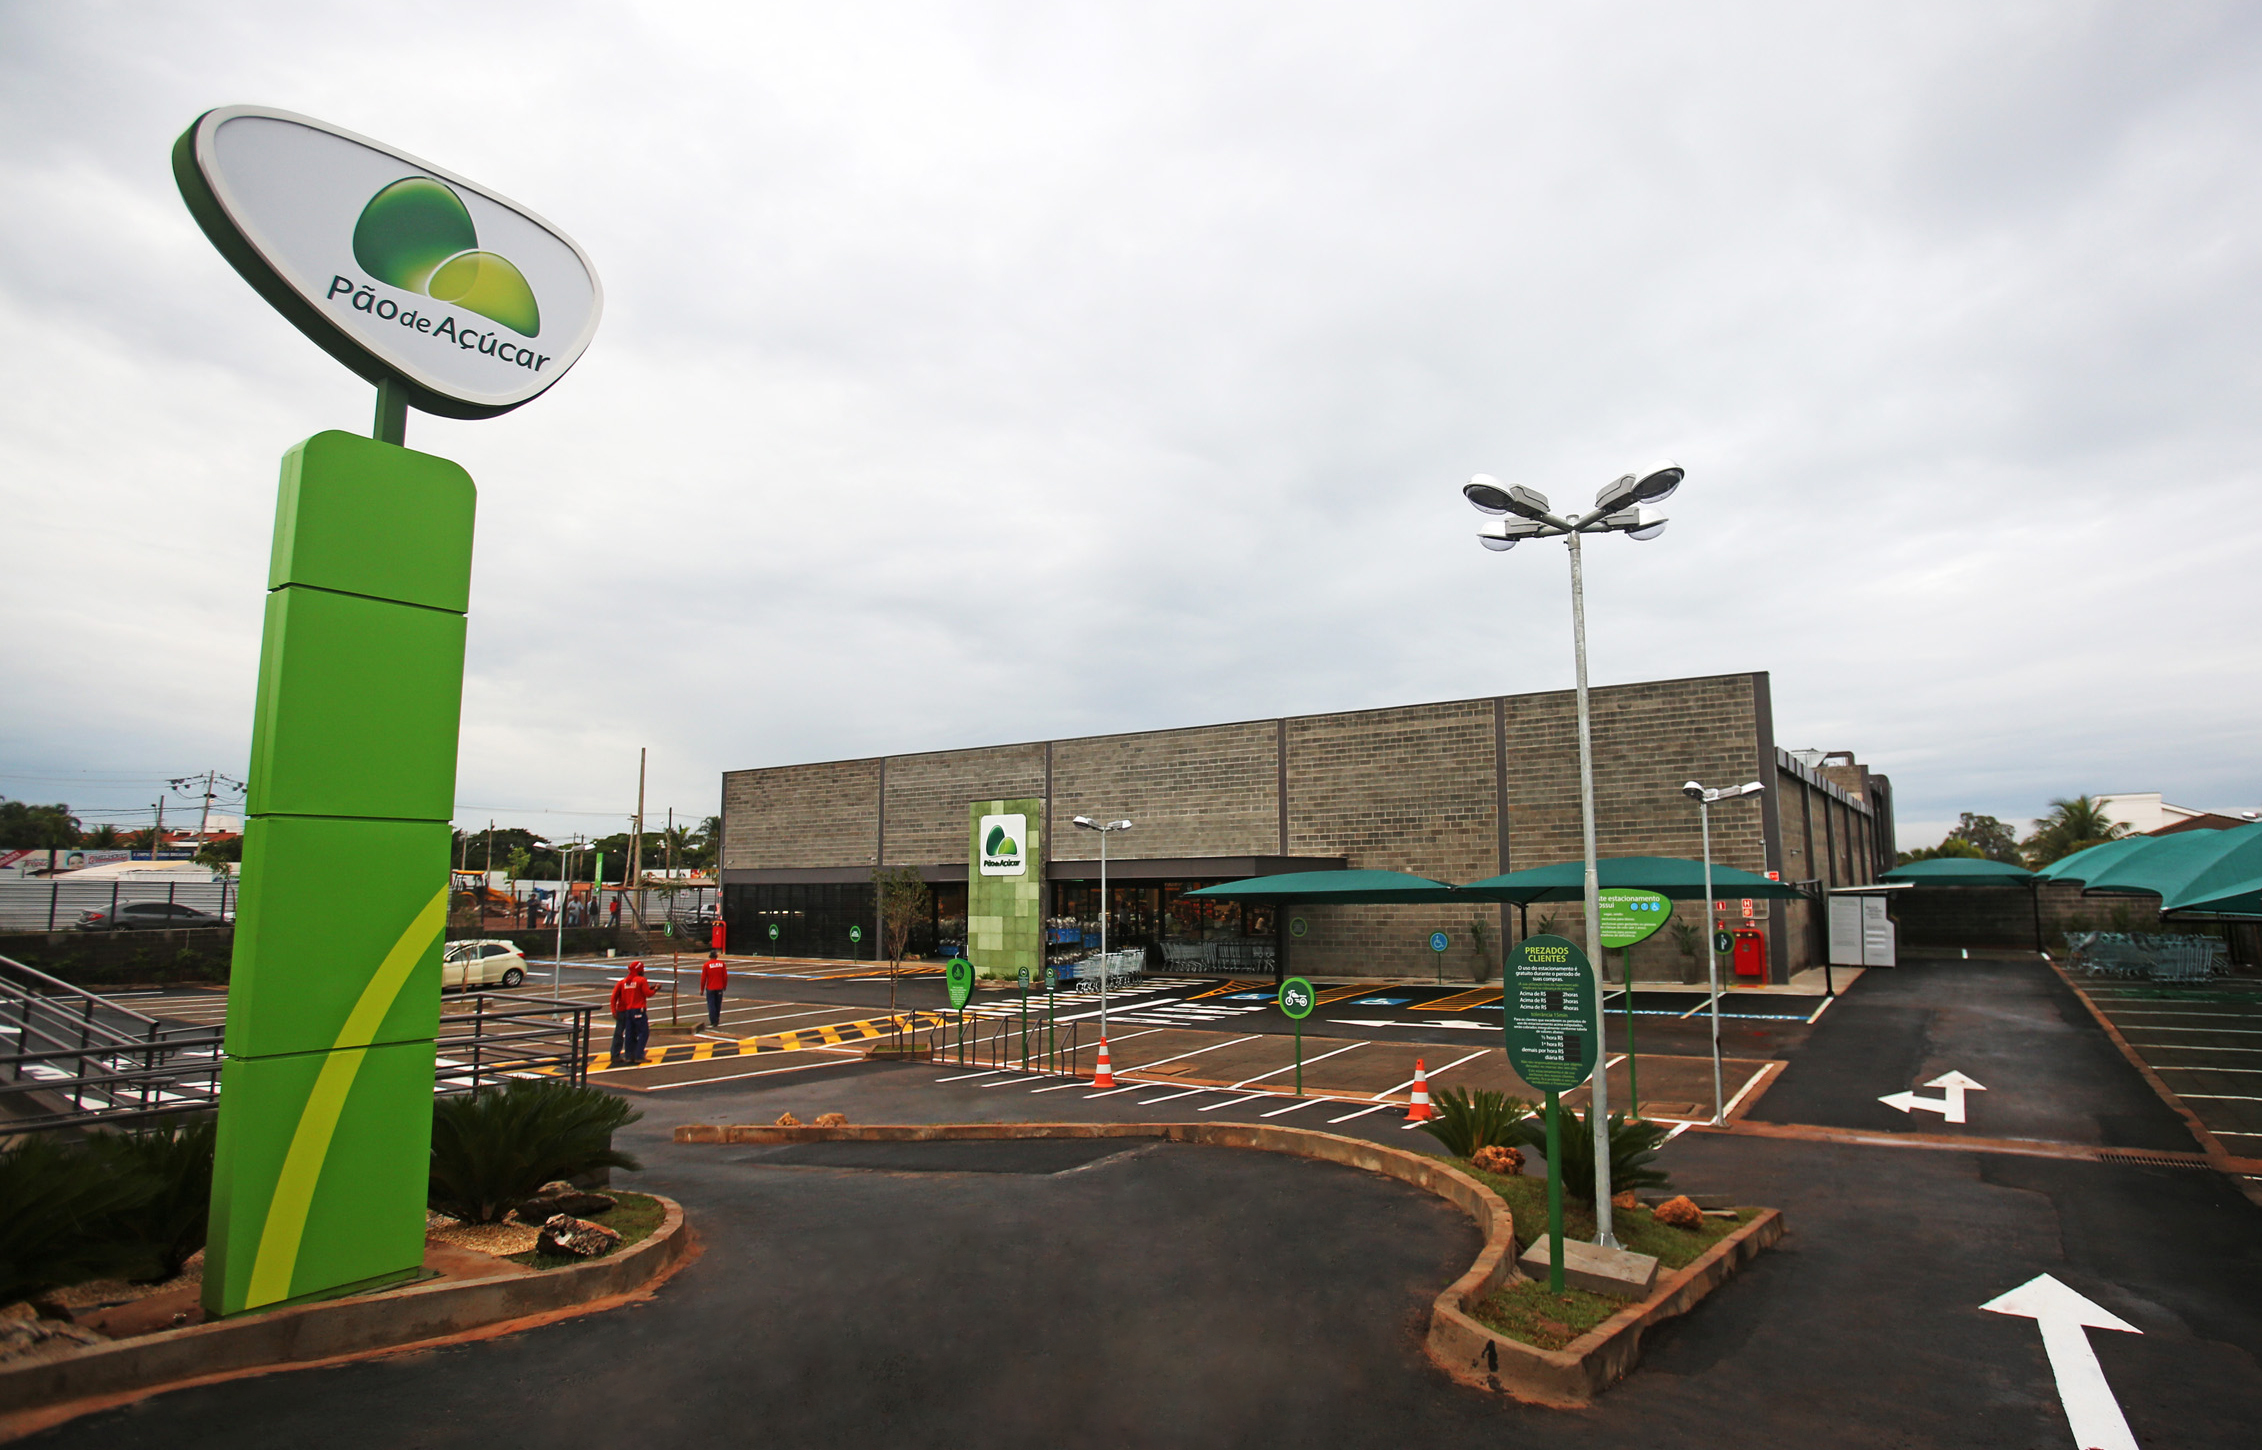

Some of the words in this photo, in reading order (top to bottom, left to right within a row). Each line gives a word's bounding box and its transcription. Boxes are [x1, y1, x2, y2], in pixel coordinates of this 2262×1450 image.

[327, 275, 398, 320] Pão
[400, 311, 431, 333] de
[432, 316, 551, 372] Açúcar
